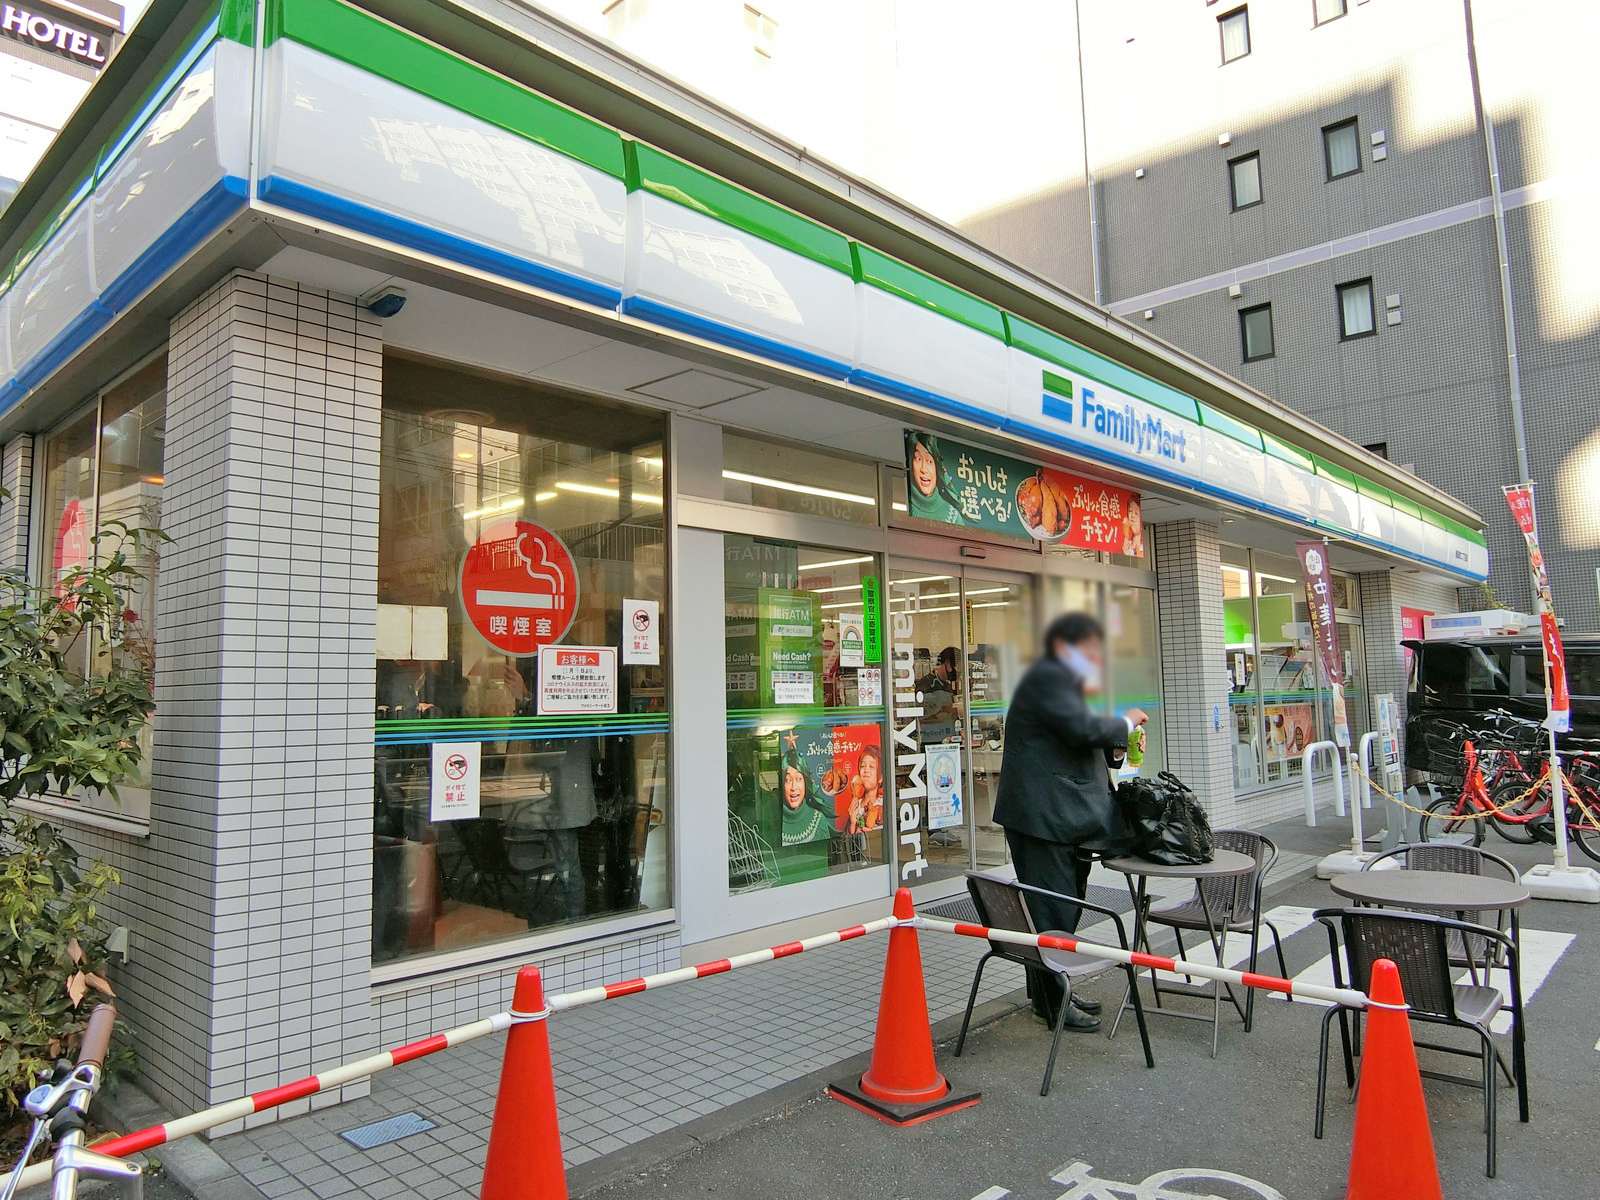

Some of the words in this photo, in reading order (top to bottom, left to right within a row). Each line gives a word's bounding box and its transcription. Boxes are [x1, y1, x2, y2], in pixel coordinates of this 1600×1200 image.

[2, 4, 106, 63] HOTEL
[1081, 387, 1187, 464] FamilyMart
[957, 452, 1008, 495] おいしさ
[959, 485, 1012, 523] 選べる!
[1080, 514, 1119, 544] チキン!
[489, 615, 552, 637] 喫煙室
[561, 654, 596, 665] お客様へ
[634, 641, 649, 650] 禁止
[772, 651, 789, 661] Need
[790, 651, 812, 662] Cash?
[893, 582, 929, 881] FamilyMart
[445, 791, 466, 803] 禁止
